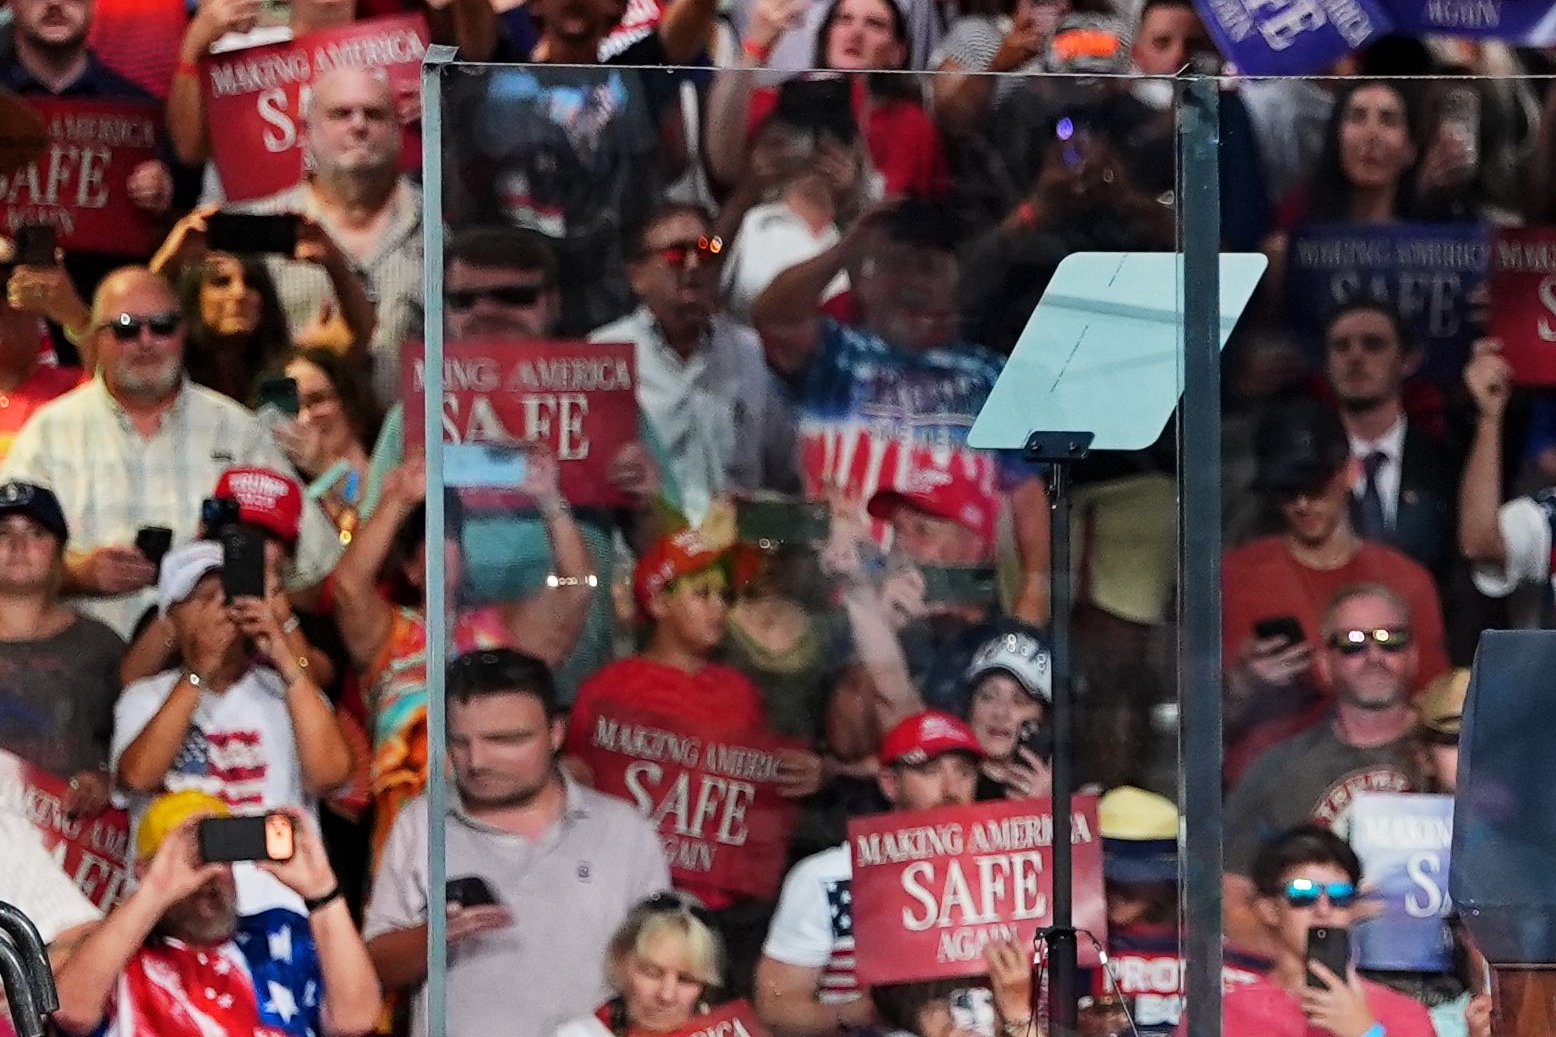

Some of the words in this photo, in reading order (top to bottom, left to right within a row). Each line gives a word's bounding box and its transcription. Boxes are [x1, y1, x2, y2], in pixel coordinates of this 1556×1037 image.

[503, 355, 632, 391] AMERICA
[593, 714, 702, 768] MAKING
[624, 759, 755, 847] SAFE
[857, 822, 965, 867] MAKING
[967, 811, 1093, 855] AMERIA
[901, 849, 1048, 932] SAFE
